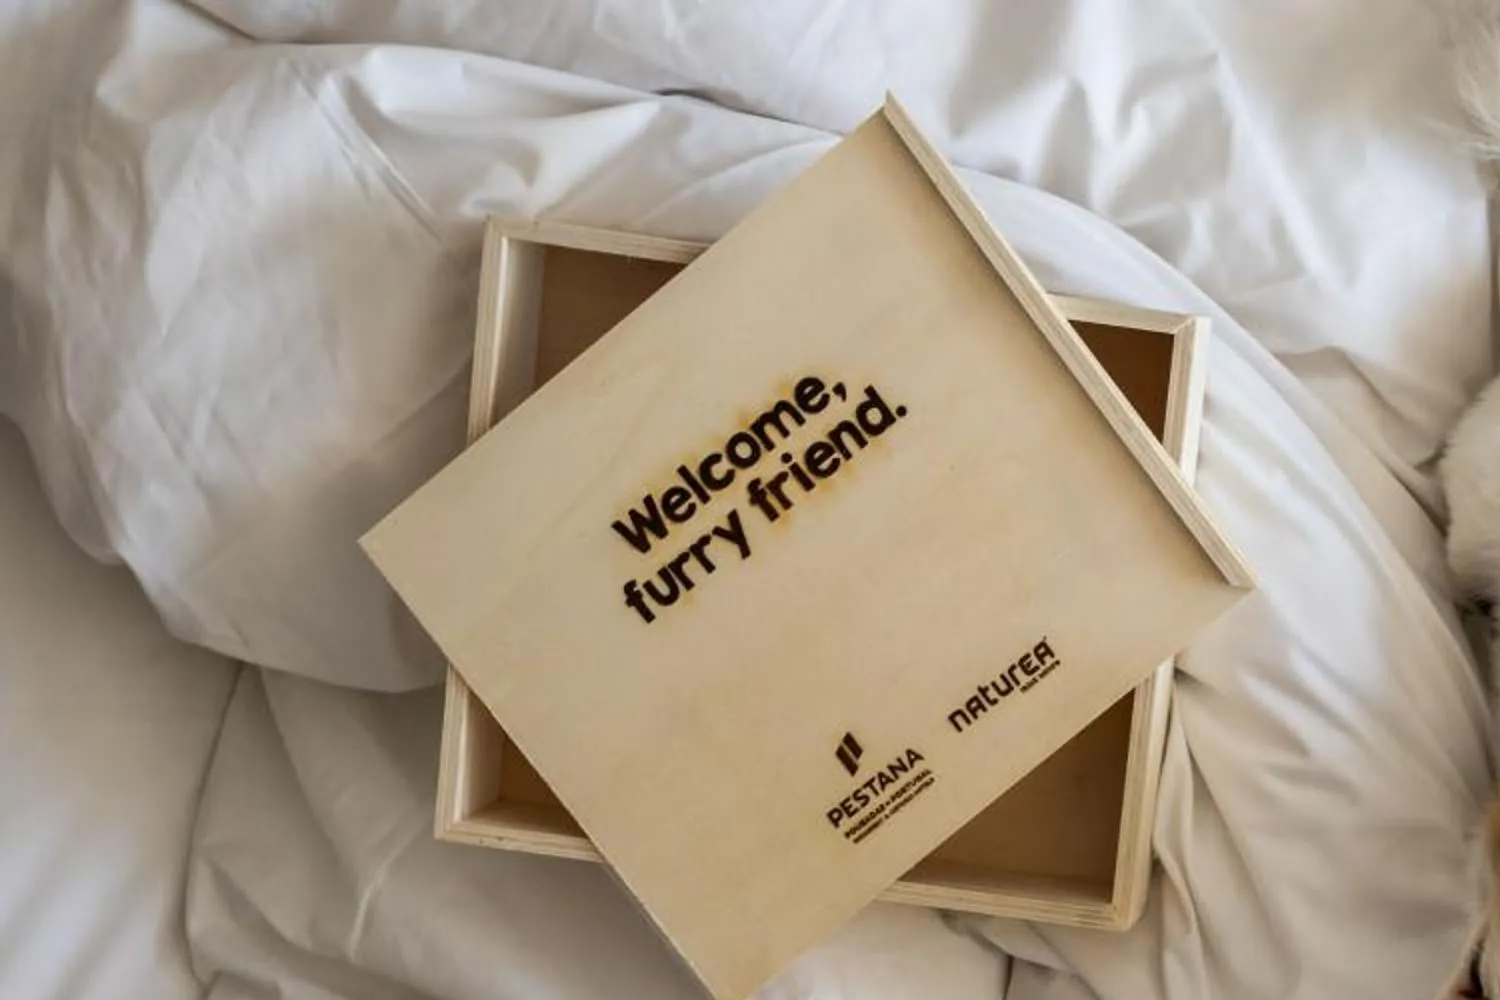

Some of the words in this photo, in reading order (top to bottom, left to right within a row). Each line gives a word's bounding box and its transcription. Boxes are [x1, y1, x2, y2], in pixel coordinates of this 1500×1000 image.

[611, 376, 847, 554] Welcome,
[622, 508, 751, 624] furry
[746, 385, 908, 522] friend.
[827, 750, 924, 828] PESTANA
